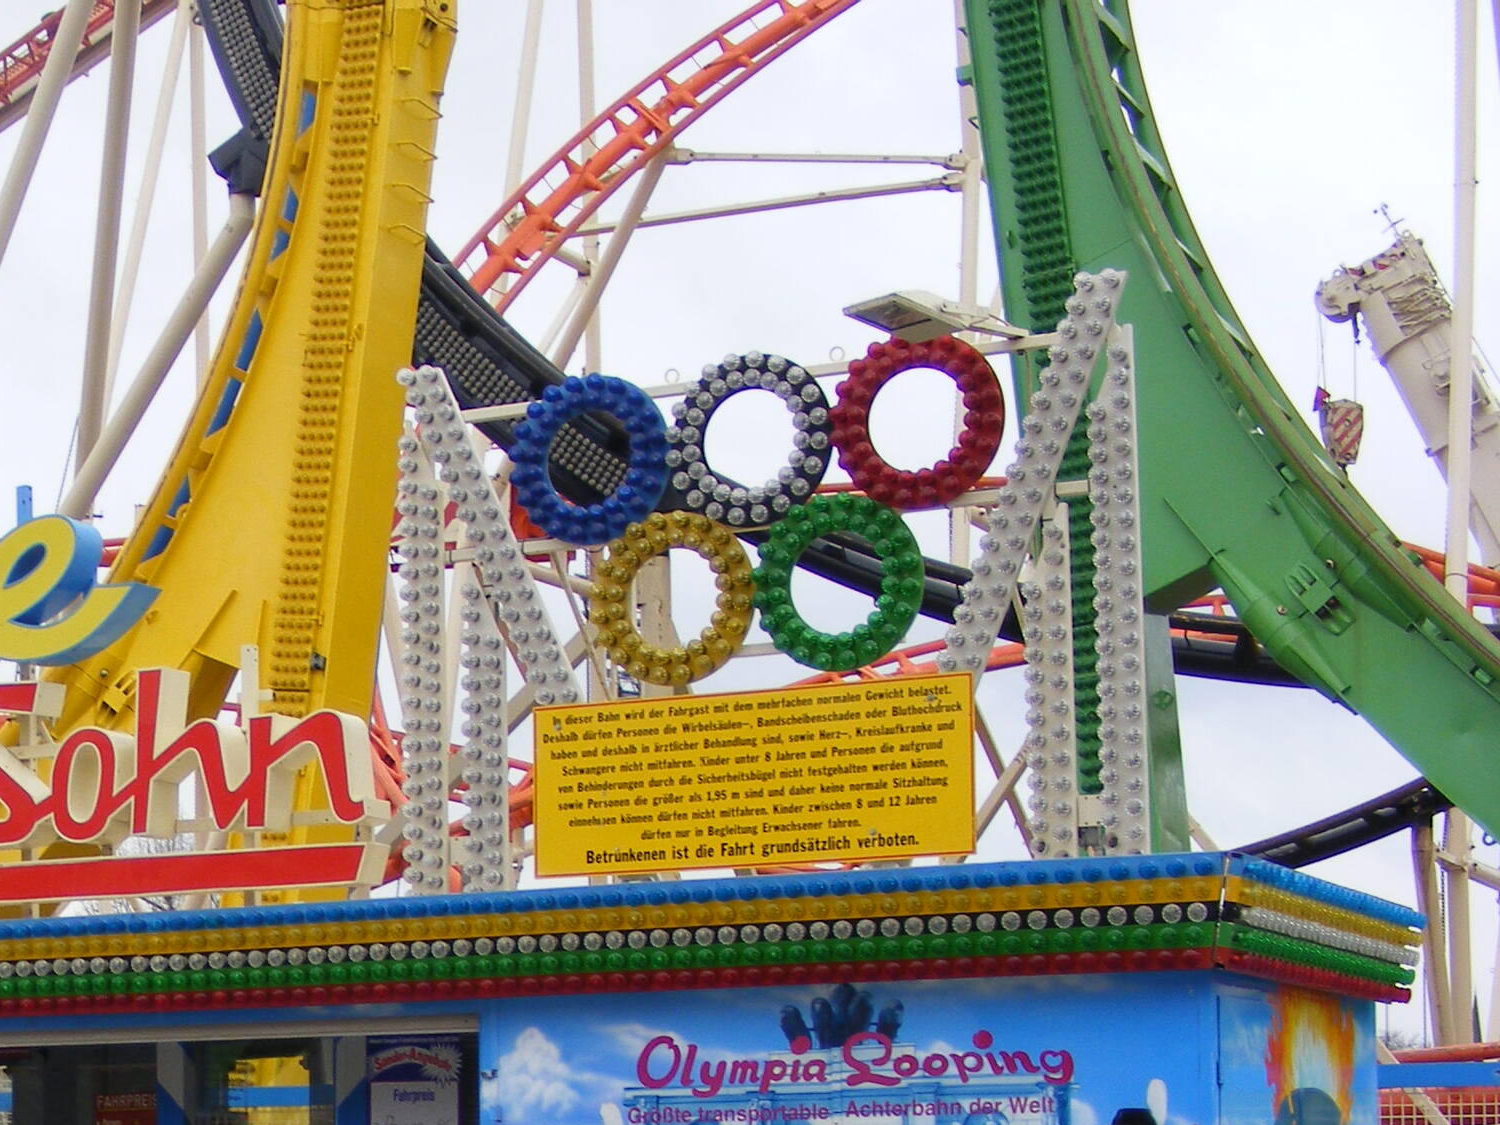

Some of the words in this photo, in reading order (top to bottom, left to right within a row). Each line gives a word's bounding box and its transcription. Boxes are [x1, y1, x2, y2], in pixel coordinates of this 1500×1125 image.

[543, 732, 579, 744] Deshalb
[582, 729, 613, 740] dürfen
[616, 726, 659, 738] Personen
[663, 724, 677, 735] die
[757, 711, 861, 728] Bandscheibenschaden
[865, 708, 887, 719] oder
[892, 701, 962, 717] Bluthochdruck
[565, 714, 593, 725] dieser
[597, 712, 620, 722] Bahn
[625, 709, 645, 720] wird
[649, 708, 664, 719] der
[668, 705, 709, 717] Fahrgast
[713, 703, 729, 713] mit
[733, 702, 753, 712] dem
[757, 697, 813, 710] mehrfachen
[817, 693, 861, 705] normalen
[865, 688, 904, 701] Gewicht
[908, 685, 952, 698] belastet.
[550, 750, 578, 760] haben
[581, 747, 598, 757] und
[602, 744, 638, 756] deshalb
[641, 743, 650, 754] in
[654, 740, 698, 753] ärztlicher
[704, 736, 757, 750] Behandlung
[789, 731, 815, 743] sowie
[856, 722, 932, 737] Kreislaufkranke
[937, 720, 955, 731] und
[562, 763, 616, 776] Schwangere
[620, 761, 643, 772] nicht
[647, 758, 696, 770] mitfahren.
[735, 753, 760, 764] unter
[764, 752, 771, 762] 8
[776, 750, 806, 761] Jahren
[810, 747, 827, 759] und
[831, 745, 876, 757] Personen
[880, 742, 895, 753] die
[899, 738, 943, 753] aufgrund
[558, 785, 573, 794] von
[577, 780, 644, 793] Behinderungen
[648, 777, 675, 788] durch
[679, 775, 692, 786] die
[697, 768, 776, 784] Sicherheitsbügel
[779, 768, 803, 779] nicht
[807, 763, 867, 777] festgehalten
[872, 760, 907, 771] werden
[558, 800, 583, 811] sowie
[587, 797, 630, 809] Personen
[634, 795, 648, 806] die
[652, 793, 683, 807] größer
[688, 792, 702, 802] als
[731, 791, 741, 800] m
[744, 788, 764, 799] sind
[768, 786, 785, 797] und
[789, 785, 815, 796] daher
[820, 783, 845, 793] keine
[849, 780, 888, 791] normale
[893, 776, 948, 789] Sitzhaltung
[621, 813, 653, 824] können
[657, 810, 688, 822] dürfen
[692, 809, 715, 819] nicht
[720, 806, 768, 817] mitfahren.
[773, 804, 804, 815] Kinder
[809, 800, 852, 812] zwischen
[856, 799, 863, 809] 8
[867, 797, 884, 808] und
[889, 796, 901, 807] 12
[905, 794, 937, 806] Jahren
[641, 829, 671, 840] dürfen
[675, 828, 691, 838] nur
[695, 826, 704, 837] in
[708, 824, 758, 837] Begleitung
[762, 820, 823, 833] Erwachsener
[828, 818, 861, 829] fahren.
[586, 848, 666, 864] Betrunkenen
[672, 846, 689, 860] ist
[695, 844, 714, 859] die
[721, 841, 754, 857] Fahrt
[761, 836, 851, 858] grundsätzlich
[857, 833, 919, 849] verboten.
[636, 1034, 827, 1098] Olympia
[842, 1029, 1074, 1086] Looping
[628, 1105, 692, 1124] Größte
[699, 1104, 830, 1125] transportable
[845, 1098, 962, 1118] Achterbahn
[969, 1098, 1002, 1115] der
[1009, 1096, 1055, 1114] Welt
